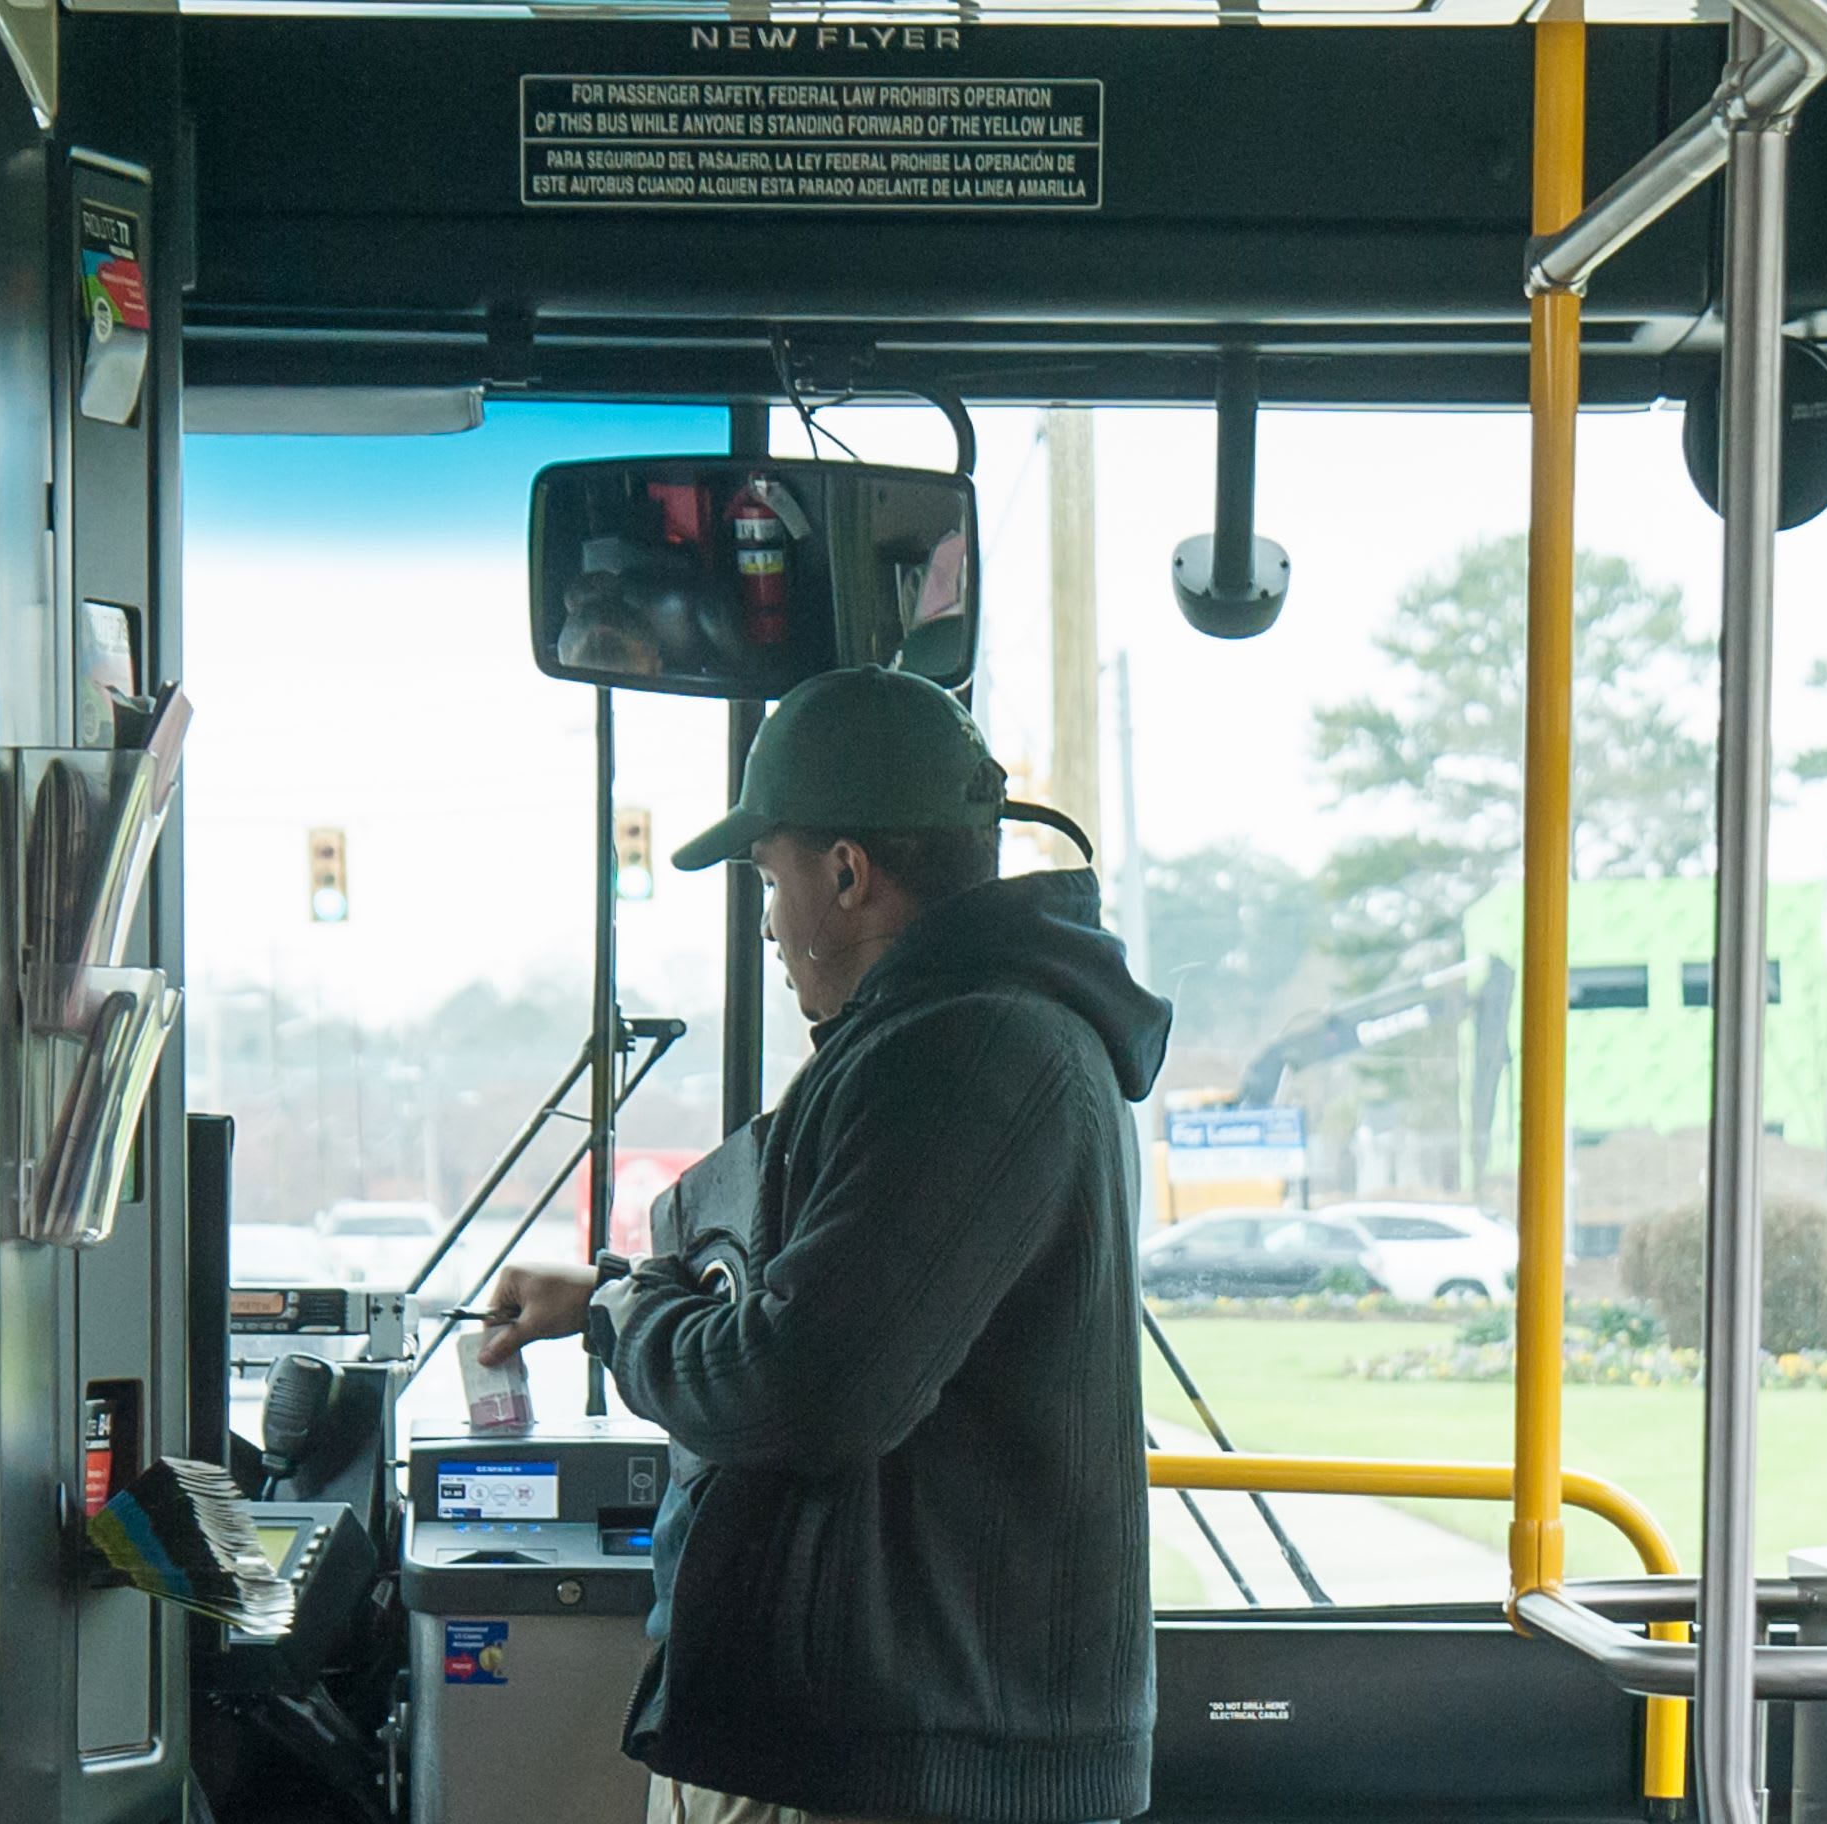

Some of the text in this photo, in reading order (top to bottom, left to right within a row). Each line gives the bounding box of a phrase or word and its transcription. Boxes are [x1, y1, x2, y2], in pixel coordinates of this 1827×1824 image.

[691, 26, 961, 50] NEW FLYER
[572, 83, 1052, 109] FOR PASSENGER SAFETY, FEDERAL LAW PROHIBITS OPERATION
[535, 111, 1084, 137] OF THIS BUS WHILE ANYONE IS STANDING FORWARD OF THE YELLOW LINE
[547, 150, 584, 169] PARA
[587, 151, 665, 170] SEGURIDAD
[669, 151, 694, 170] DEL
[775, 152, 793, 170] LA
[797, 152, 822, 171] LEY
[825, 153, 887, 172] FEDERAL
[890, 153, 951, 172] PROHIBE
[954, 154, 971, 172] LA
[1057, 154, 1075, 173] DE
[533, 174, 1086, 198] ESTE AUTOBUS CUANDO ALGUIEN ESTA PARADO ADELANTE DE LA LINEA AMARILLA
